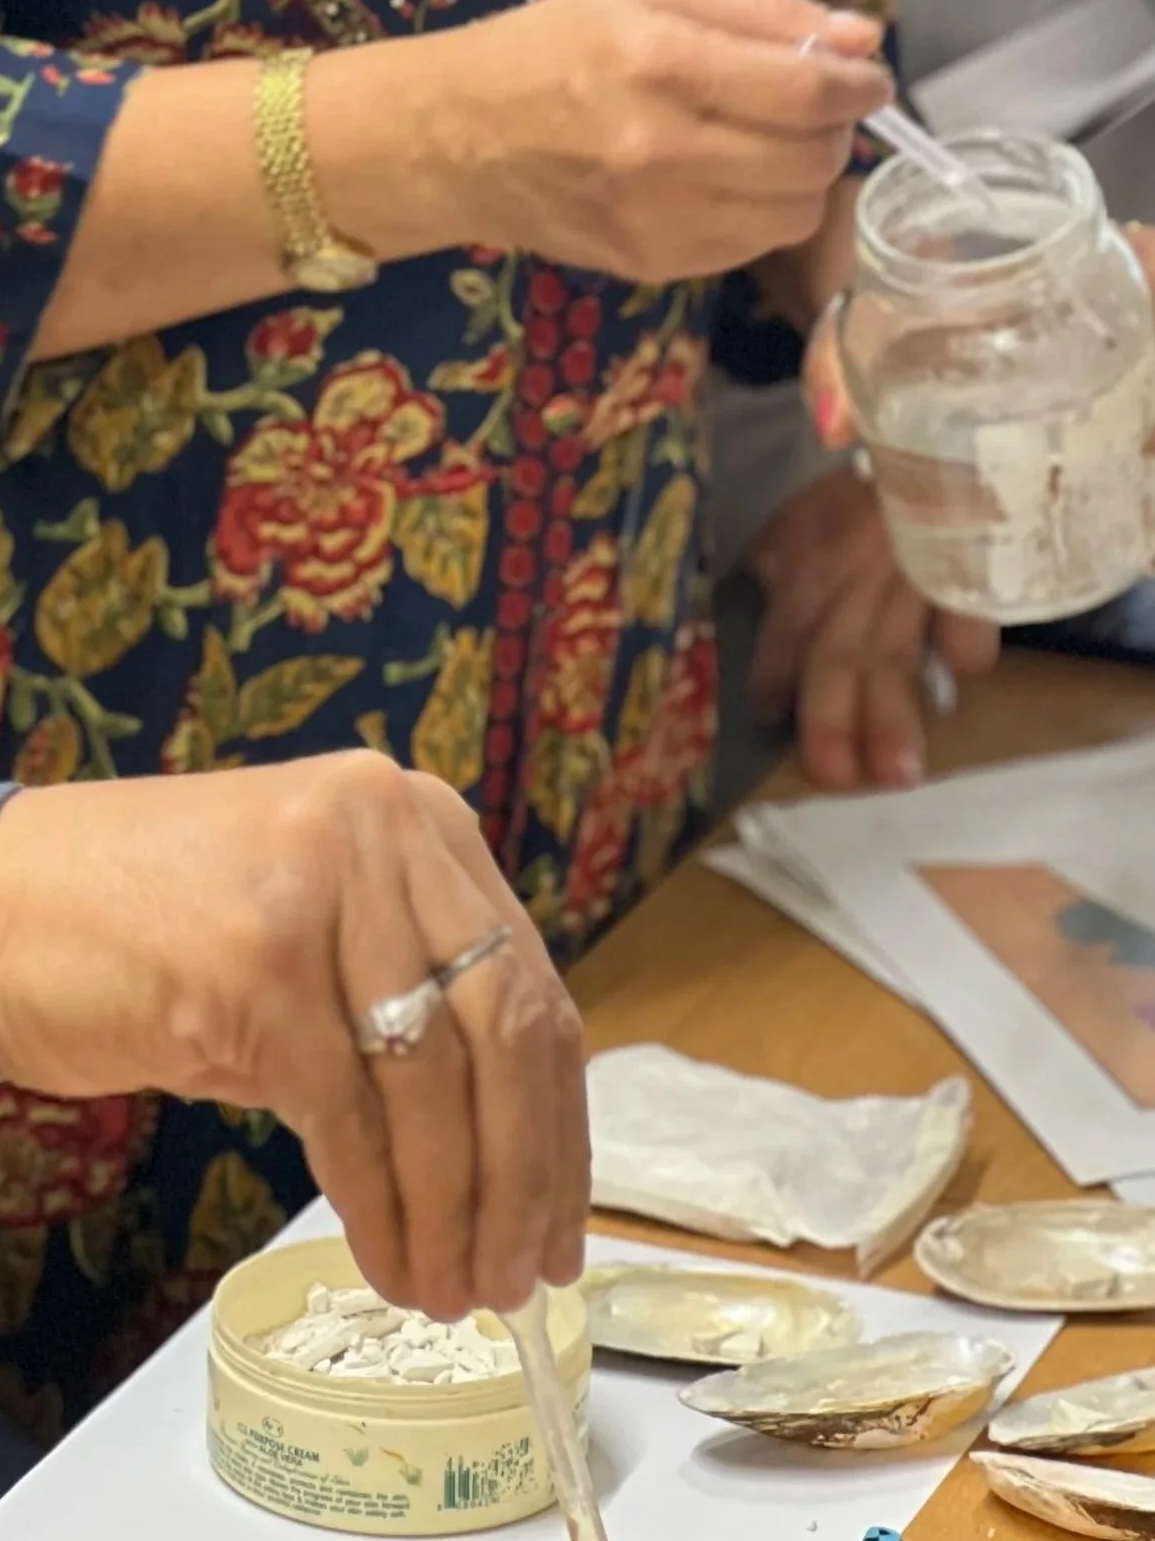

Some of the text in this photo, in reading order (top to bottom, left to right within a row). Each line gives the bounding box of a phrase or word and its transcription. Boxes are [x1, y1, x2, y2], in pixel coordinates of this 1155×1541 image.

[249, 1428, 285, 1451] PURPOSE
[287, 1445, 320, 1462] CREAM
[280, 1453, 303, 1466] VERA
